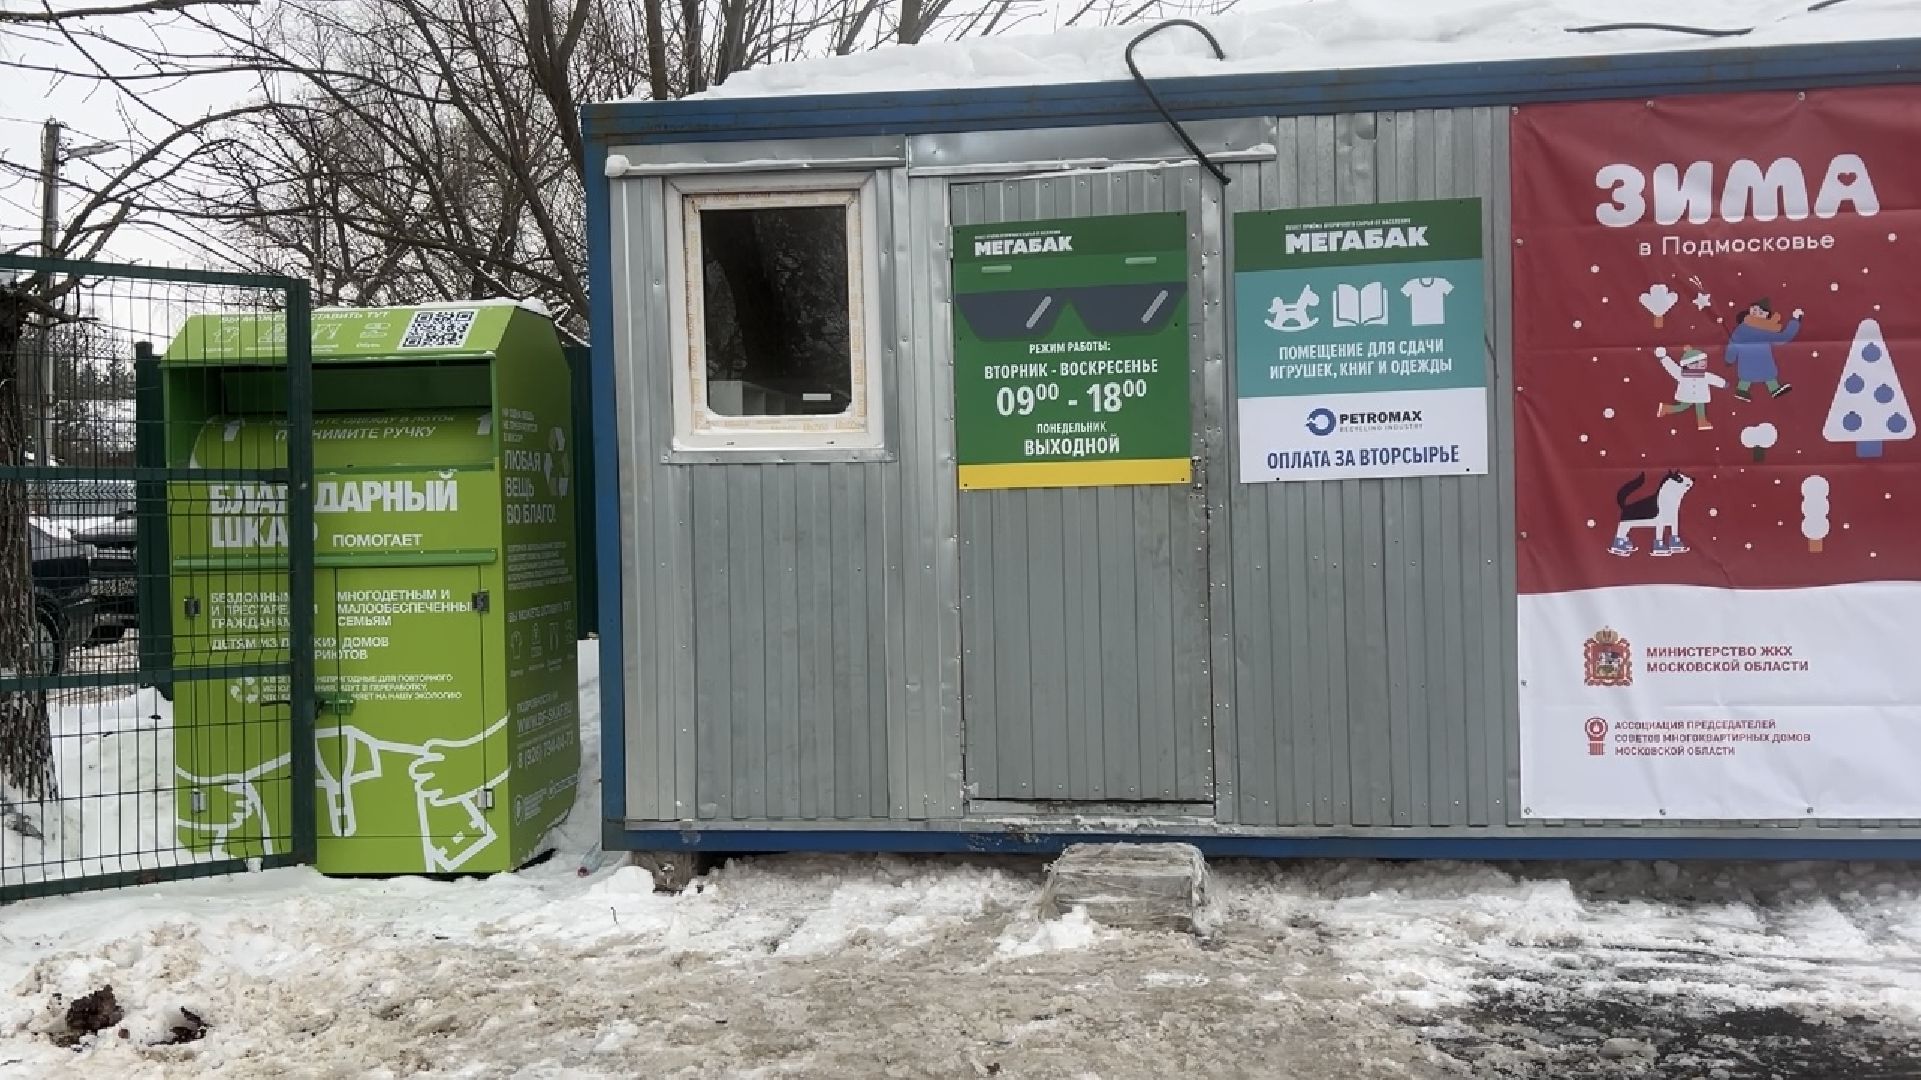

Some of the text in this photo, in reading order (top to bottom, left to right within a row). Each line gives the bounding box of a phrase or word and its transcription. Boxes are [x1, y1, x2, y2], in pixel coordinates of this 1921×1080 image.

[1595, 153, 1880, 227] ЗИМА
[975, 236, 1073, 257] МЕГАБАК
[1285, 227, 1429, 254] МЕГАБАК
[1662, 233, 1835, 257] Подмосковье
[1029, 341, 1111, 354] РЕЖИМ РАБОТЫ:
[1279, 338, 1444, 361] ПОМЕЩЕНИЕ ДЛЯ СДАЧИ
[984, 363, 1048, 380] ВТОРНИК
[1060, 359, 1158, 377] ВОСКРЕСЕНЬЕ
[1270, 357, 1452, 380] ИГРУШЕК, КНИГ И ОДЕЖДЫ
[1037, 421, 1107, 435] ПОНЕДЕЛЬНИК
[1339, 410, 1422, 425] PETROMAX
[383, 425, 437, 439] РУЧКУ
[1024, 433, 1120, 456] ВЫХОДНОЙ
[504, 450, 541, 471] ЛЮБАЯ
[1267, 445, 1459, 470] ОПЛАТА ЗА ВТОРСЫРЬЕ
[210, 469, 458, 514] БЛАГДАРНЫЙ
[506, 477, 535, 500] ВЕЩЬ
[506, 504, 521, 525] ВО
[211, 515, 423, 548] ШКА ПОМОГАЕТ
[337, 589, 451, 602] МНОГОДЕТНЫМ И
[337, 602, 472, 614] МАЛООБЕСПЕЧЕННЫ
[338, 615, 392, 627] СЕМЬЯМ
[342, 636, 389, 650] ДОМОВ
[1646, 645, 1793, 657] МИНИСТЕРСТВО ЖКХ
[1646, 659, 1809, 672] МОСКОВСКОЙ ОБЛАСТИ
[1614, 719, 1776, 732] АССОЦИАЦИЯ ПРЕДСЕДАТЕЛЕЙ
[1614, 733, 1811, 744] СОВЕТОВ МНОГОКВАРТИРНЫХ ДОМОВ
[1614, 744, 1736, 756] МОСКОВСКОЙ ОБЛАСТИ
